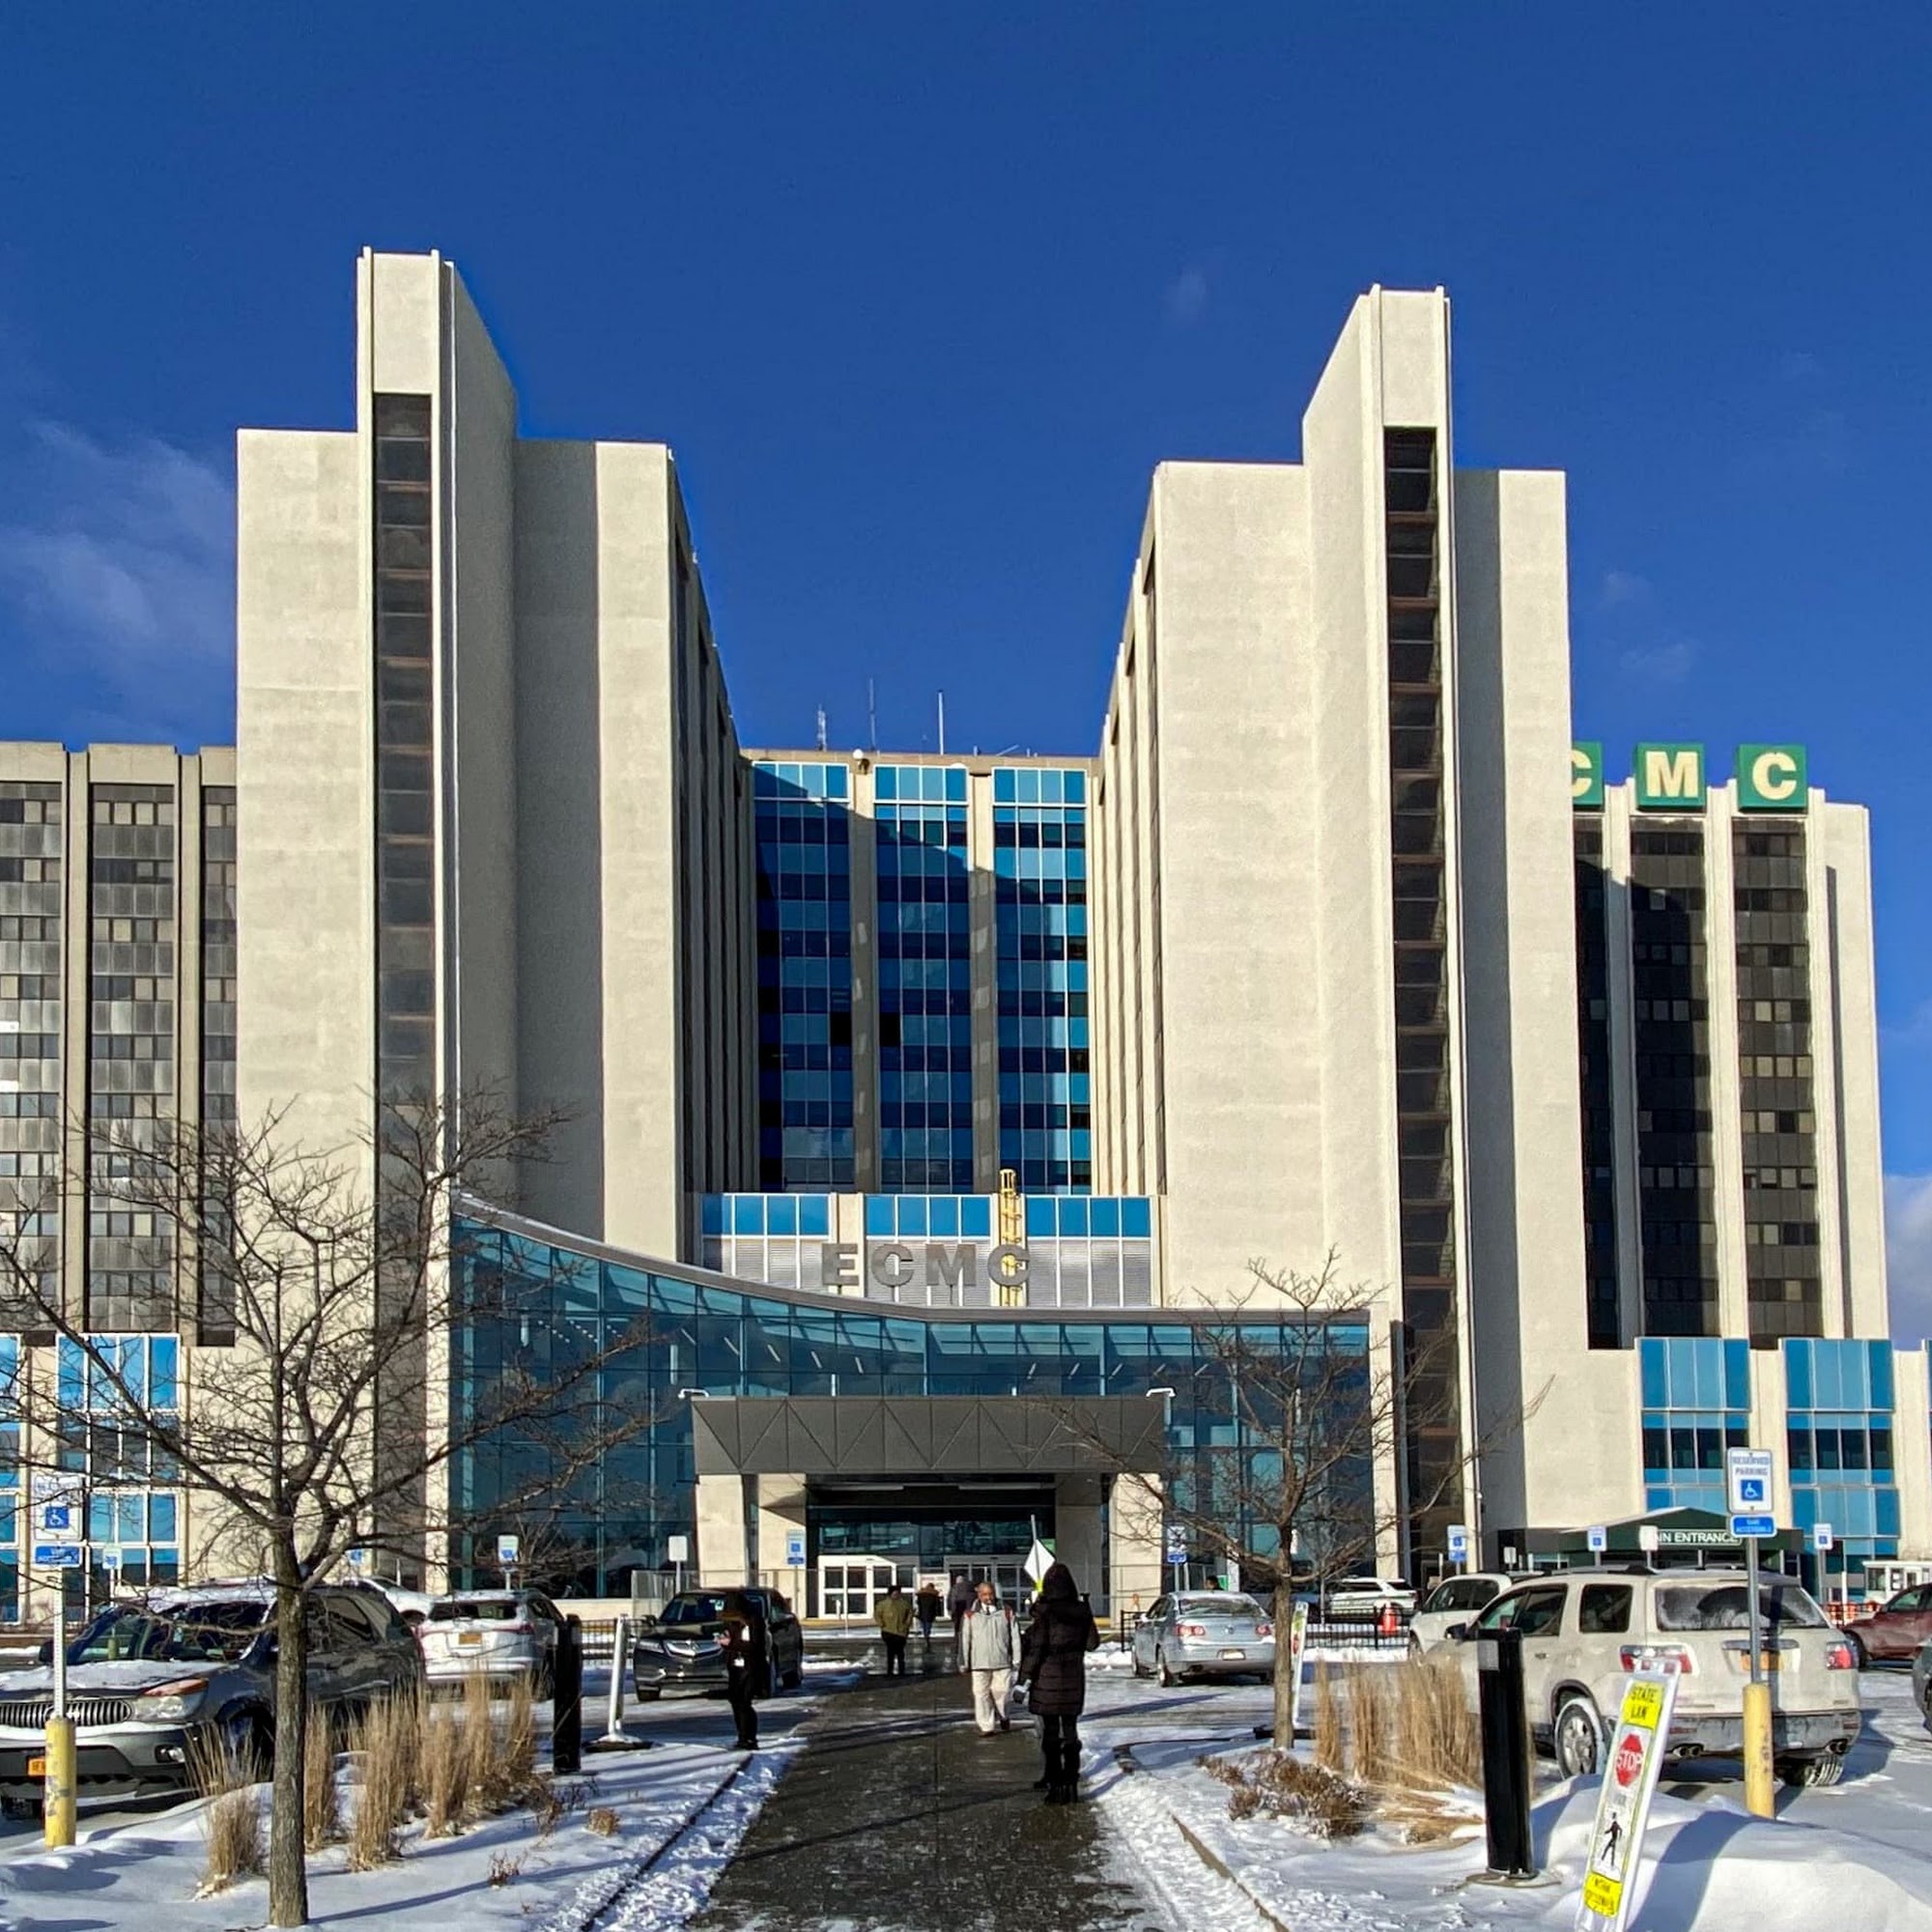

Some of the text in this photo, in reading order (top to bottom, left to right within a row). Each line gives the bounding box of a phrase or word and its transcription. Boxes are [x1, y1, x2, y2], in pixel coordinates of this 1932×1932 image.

[822, 1243, 1031, 1287] ECMC
[1630, 1687, 1658, 1703] STATE
[1617, 1750, 1643, 1770] STOP
